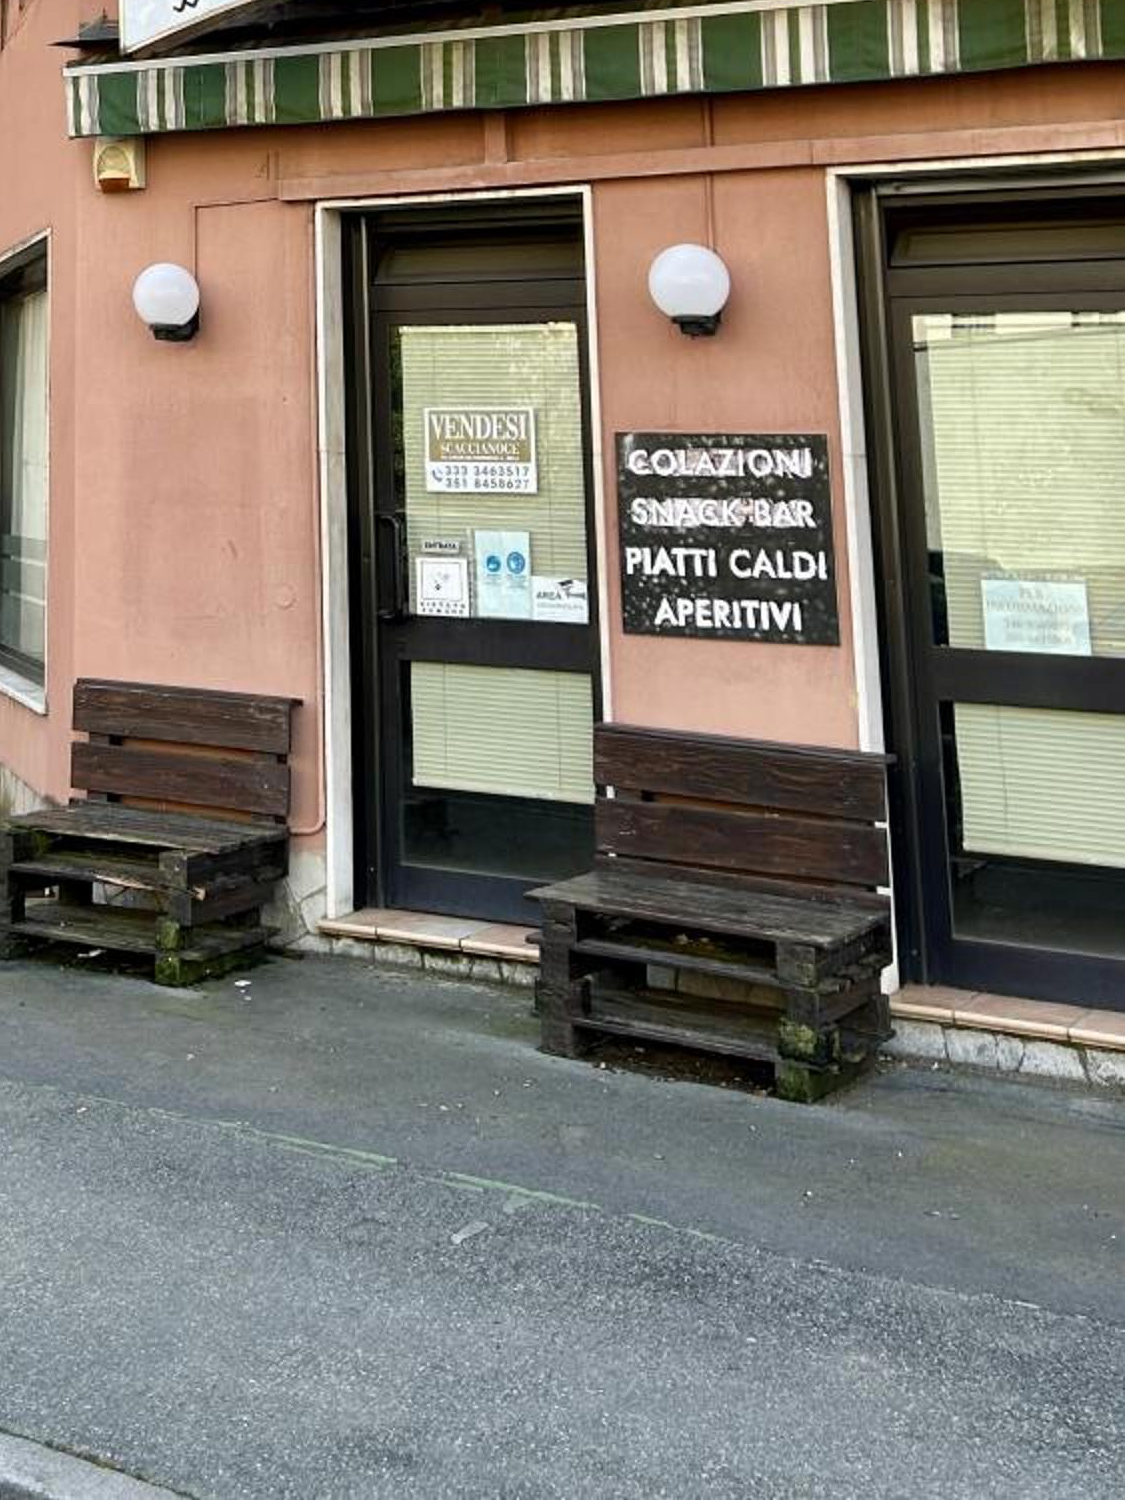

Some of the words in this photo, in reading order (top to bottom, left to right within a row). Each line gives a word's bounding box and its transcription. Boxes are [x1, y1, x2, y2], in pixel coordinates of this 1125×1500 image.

[430, 412, 528, 440] VENDESI
[628, 447, 813, 479] COLAZIONI
[629, 496, 745, 527] SNACK
[754, 497, 817, 528] BAR
[625, 546, 718, 577] PIATTI
[729, 548, 828, 581] CALDI
[654, 597, 803, 632] APERITIVI
